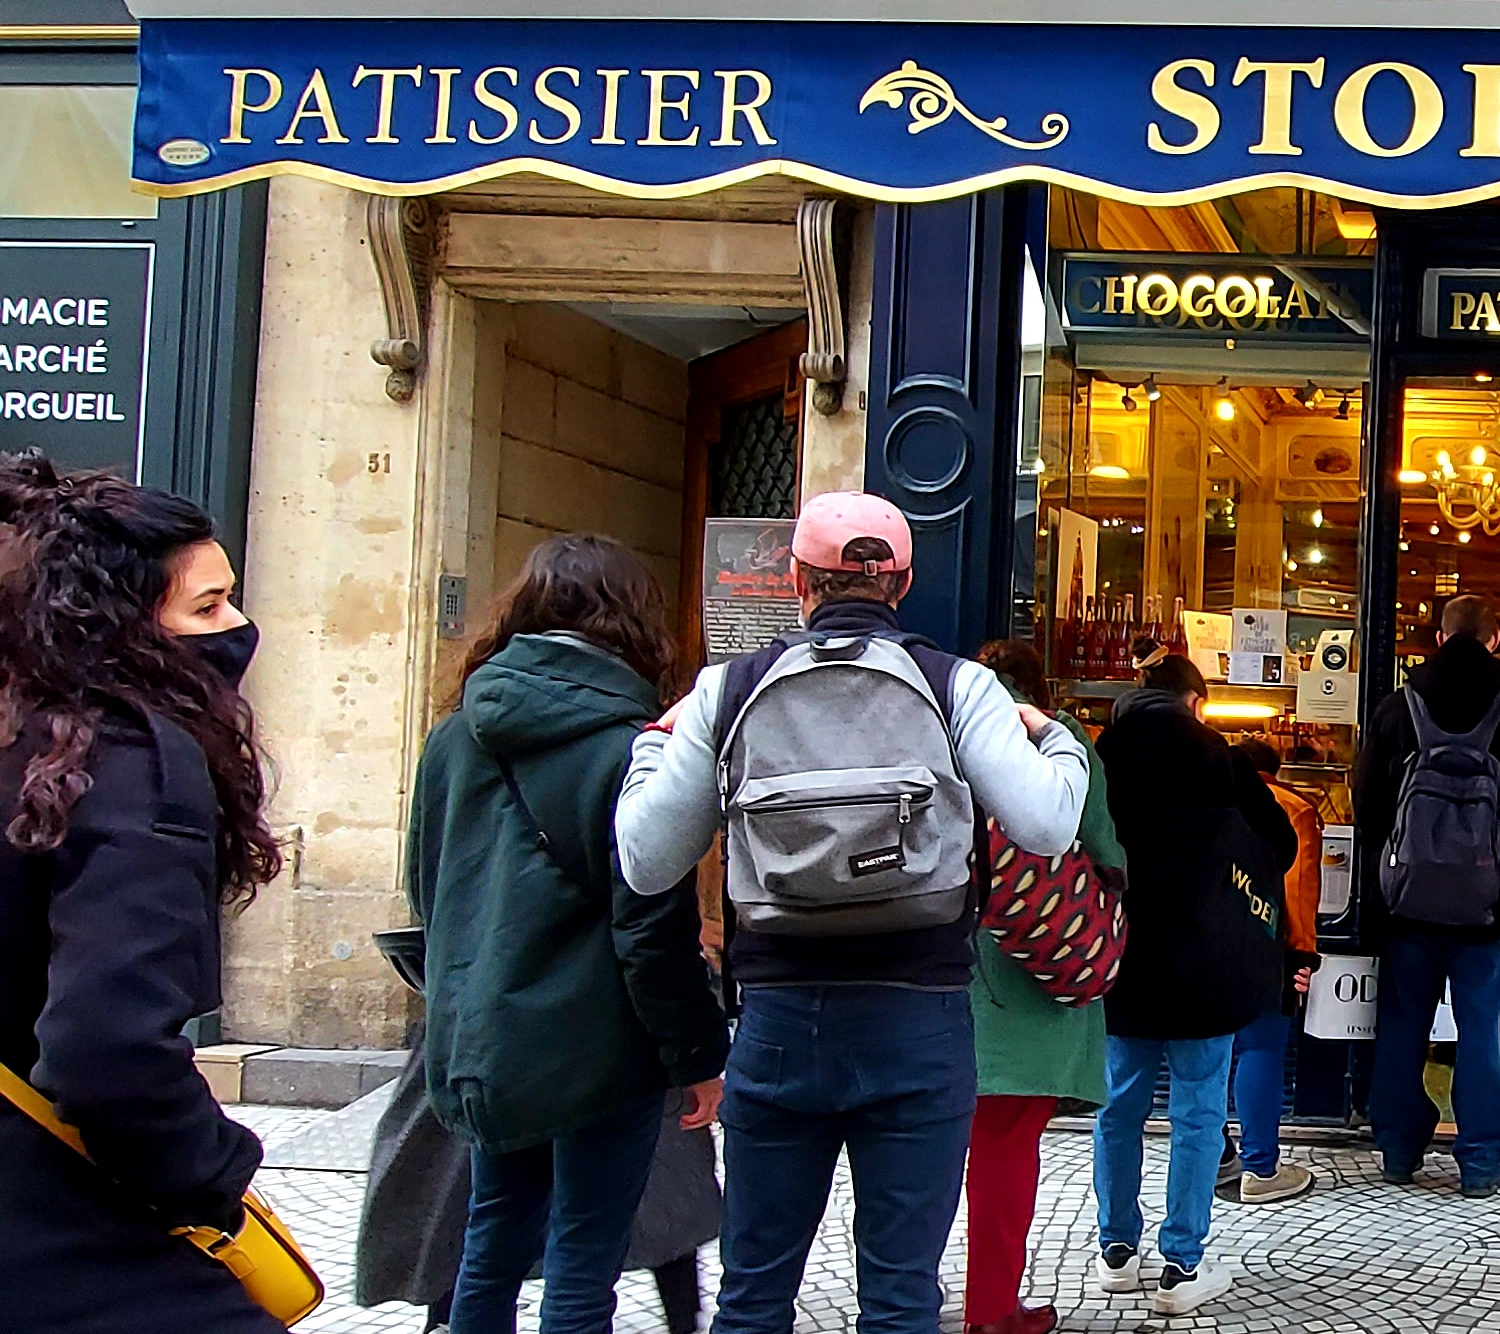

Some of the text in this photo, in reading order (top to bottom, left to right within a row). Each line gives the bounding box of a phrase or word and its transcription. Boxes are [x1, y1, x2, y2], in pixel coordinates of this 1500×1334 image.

[219, 64, 779, 148] PATISSIER
[0, 297, 109, 326] MACIE
[0, 339, 108, 373] ARCHÉ
[0, 391, 126, 421] RGUEIL
[368, 452, 391, 474] 51
